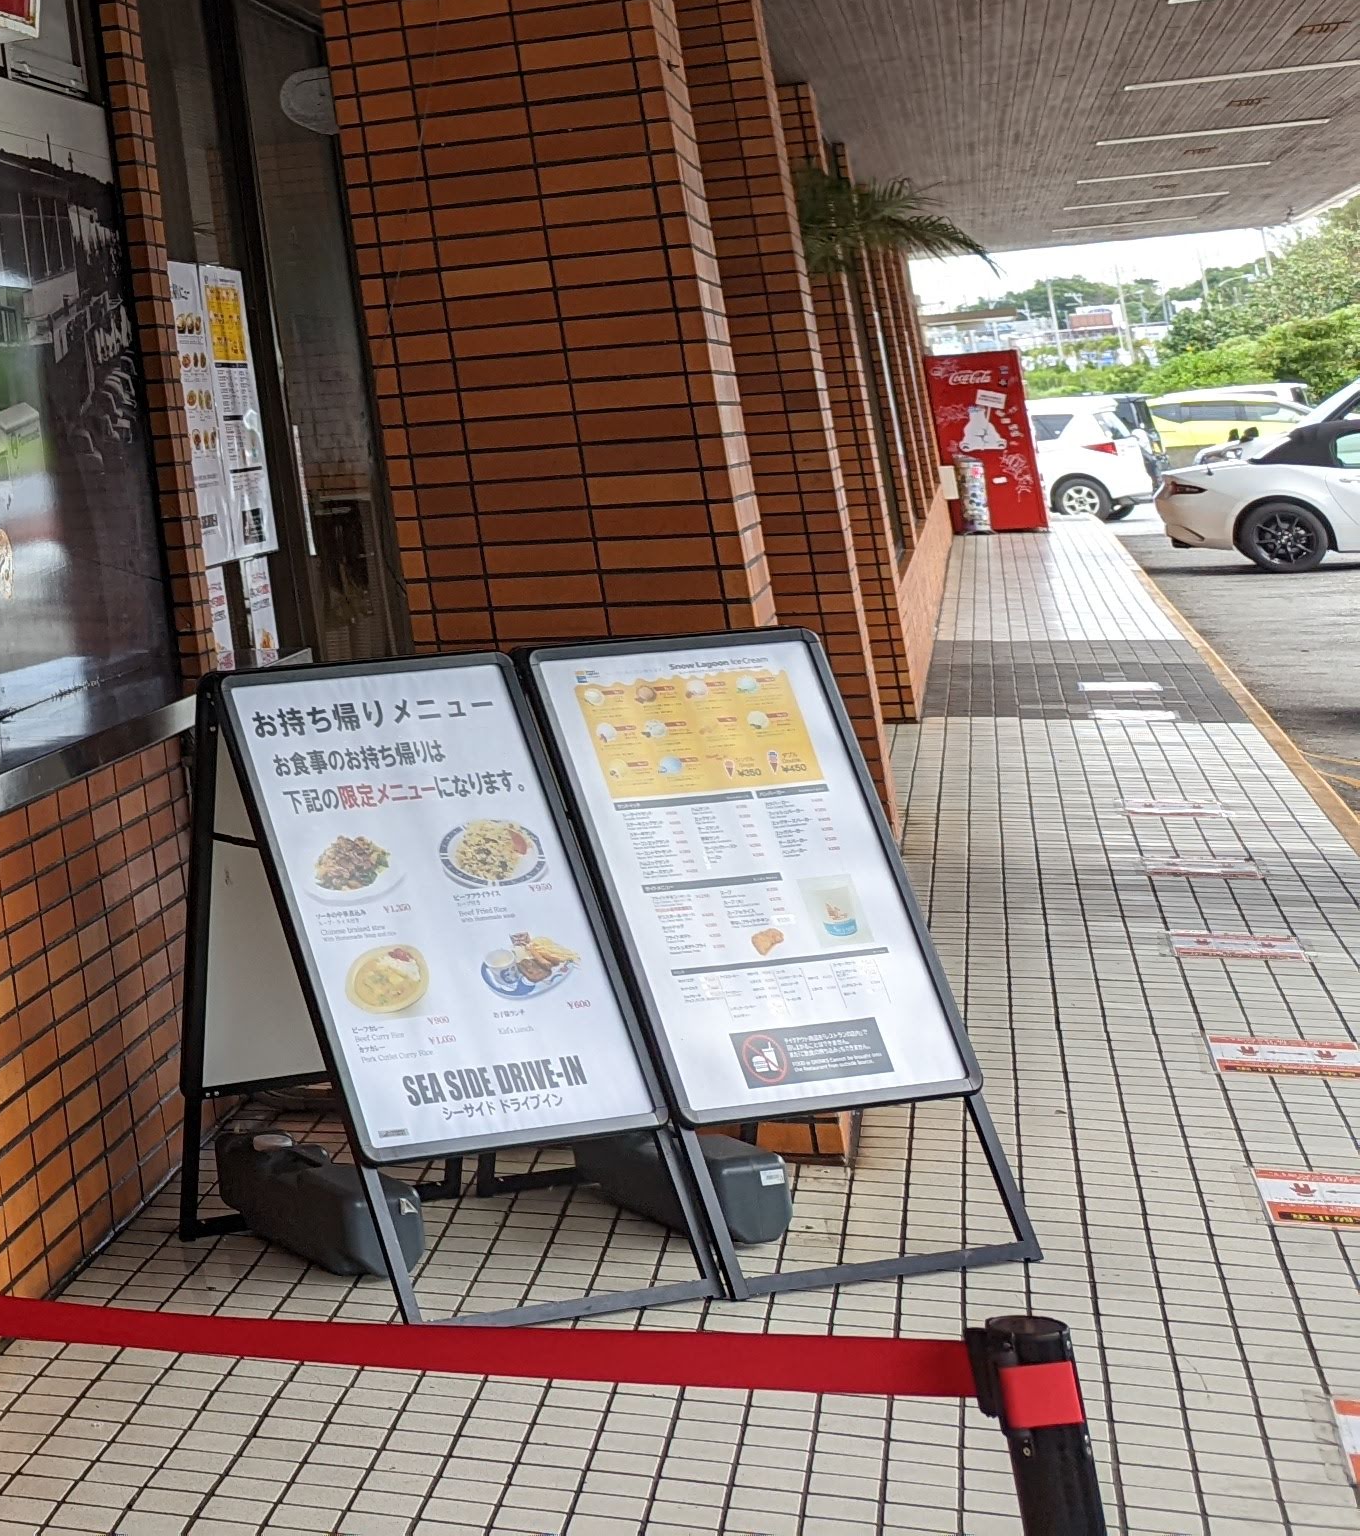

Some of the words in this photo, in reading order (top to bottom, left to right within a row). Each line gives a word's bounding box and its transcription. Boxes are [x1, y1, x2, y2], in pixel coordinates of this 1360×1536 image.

[948, 370, 993, 386] Coca-Cola
[668, 661, 694, 671] Snow
[695, 659, 730, 670] Lagoon
[273, 739, 447, 778] お食事のお持ち帰りは
[283, 769, 526, 815] 下記の限定メニューになります。
[567, 1000, 592, 1010] ¥600
[402, 1072, 447, 1107] SEA
[443, 1066, 497, 1103] SIDE
[492, 1055, 589, 1096] DRIVE-IN
[442, 1099, 496, 1121] シーサイド
